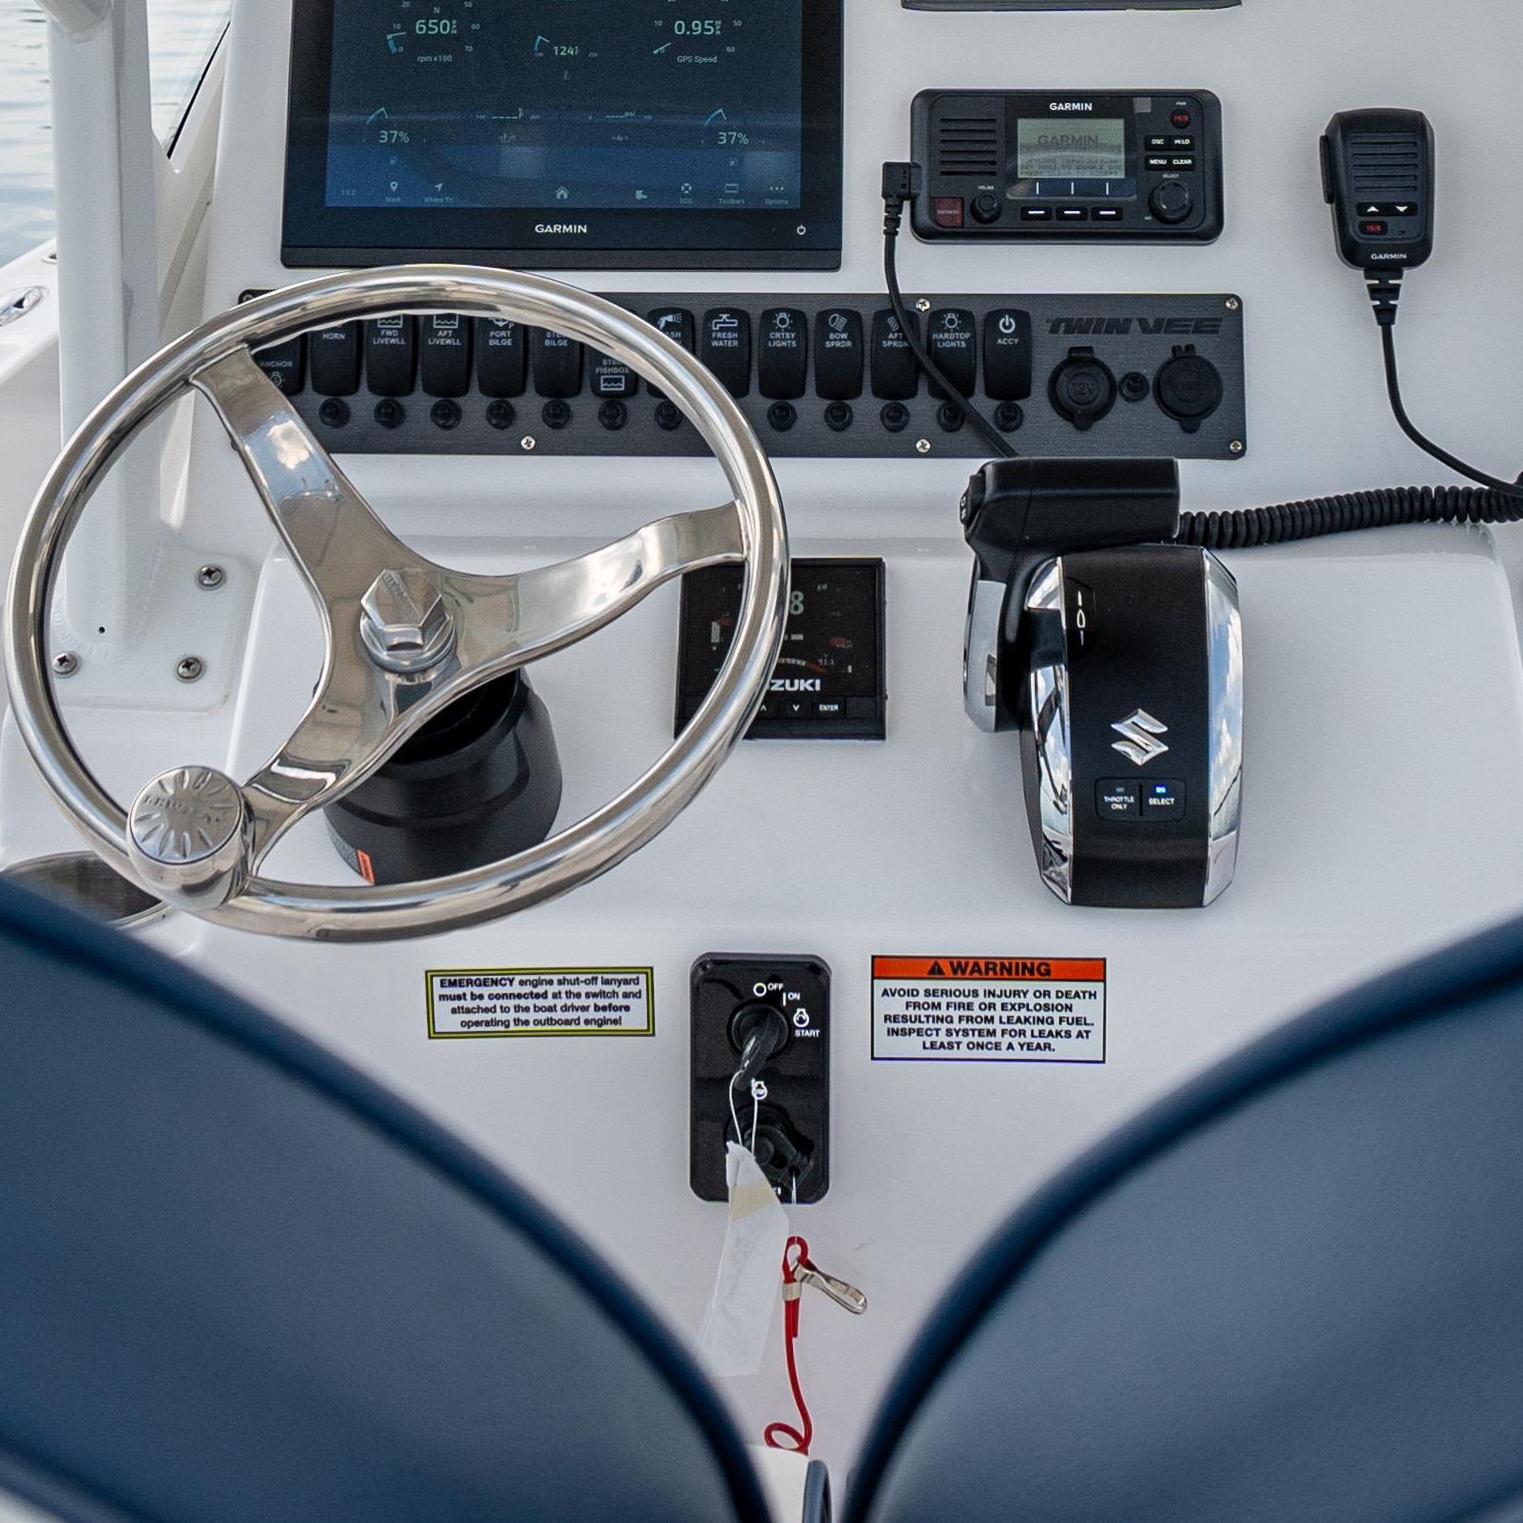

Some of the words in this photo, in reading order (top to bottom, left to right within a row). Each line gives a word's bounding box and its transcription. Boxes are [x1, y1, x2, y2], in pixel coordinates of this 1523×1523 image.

[415, 19, 451, 34] 650
[674, 20, 714, 35] 0.95
[1049, 102, 1093, 111] GARMIN
[379, 130, 410, 144] 37%
[717, 132, 749, 145] 37%
[1037, 135, 1099, 148] GARMIN
[535, 224, 587, 234] GARMIN
[1045, 317, 1134, 335] TWIN
[1136, 317, 1223, 335] VEE
[437, 330, 453, 338] AFT
[933, 332, 971, 340] HARDTOP
[373, 337, 406, 345] LIVEWLL
[428, 338, 462, 346] LIVEWLL
[489, 338, 512, 346] BILGE
[544, 339, 568, 347] BILGE
[712, 339, 739, 347] WATER
[768, 340, 797, 348] LIGHTS
[938, 340, 967, 348] LIGHTS
[997, 337, 1020, 345] ACCY
[766, 679, 821, 691] ZUKI
[819, 704, 839, 712] ENTER
[949, 962, 1051, 977] WARNING
[439, 977, 515, 989] EMERGENCY
[518, 976, 554, 989] engine
[557, 976, 598, 987] shut-off
[601, 976, 640, 988] lanyard
[767, 983, 784, 991] OFF
[438, 991, 467, 1002] must
[470, 991, 484, 1001] be
[487, 990, 548, 1001] connected
[551, 991, 562, 1000] at
[565, 990, 582, 1000] the
[584, 989, 619, 999] switch
[622, 989, 642, 999] and
[787, 992, 800, 1000] ON
[881, 988, 920, 998] AVOID
[923, 988, 980, 999] SERIOUS
[983, 989, 1029, 999] INJURY
[1033, 990, 1052, 999] OR
[1055, 990, 1097, 1000] DEATH
[450, 1004, 497, 1015] attached
[500, 1005, 511, 1014] to
[513, 1004, 530, 1014] the
[533, 1004, 557, 1013] boat
[560, 1003, 590, 1013] driver
[593, 1002, 631, 1012] before
[905, 1001, 942, 1011] FROM
[946, 1002, 974, 1011] FIRE
[978, 1002, 997, 1012] OR
[1000, 1002, 1073, 1012] EXPLOSION
[460, 1017, 510, 1030] operating
[513, 1017, 530, 1026] the
[532, 1016, 581, 1026] outboard
[583, 1016, 622, 1028] engine!
[883, 1014, 954, 1025] RESULTING
[958, 1015, 995, 1025] FROM
[999, 1015, 1054, 1025] LEAKING
[1058, 1016, 1095, 1026] FUEL.
[794, 1029, 820, 1038] START
[886, 1027, 942, 1037] INSPECT
[945, 1028, 997, 1038] SYSTEM
[1001, 1029, 1027, 1038] FOR
[1030, 1029, 1072, 1039] LEAKS
[1075, 1030, 1092, 1039] AT
[922, 1041, 963, 1050] LEAST
[966, 1041, 1002, 1051] ONCE
[1006, 1041, 1015, 1051] A
[1018, 1042, 1056, 1052] YEAR.
